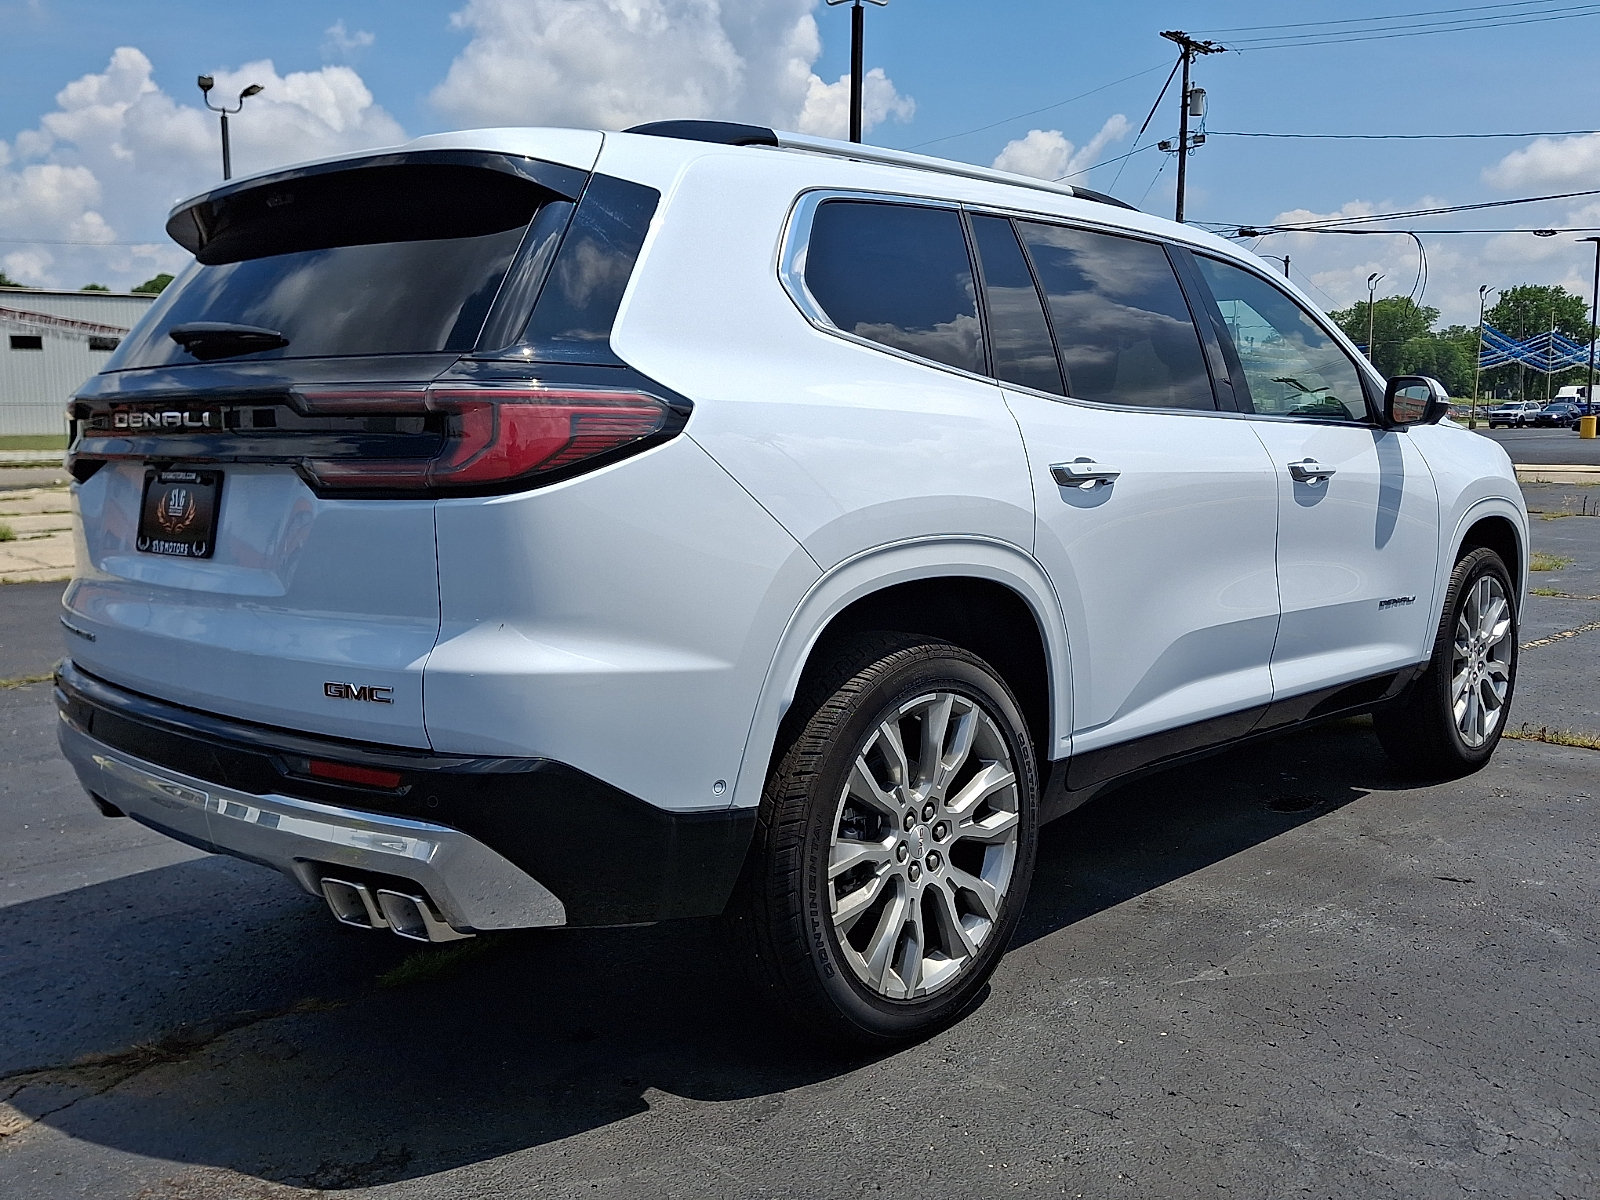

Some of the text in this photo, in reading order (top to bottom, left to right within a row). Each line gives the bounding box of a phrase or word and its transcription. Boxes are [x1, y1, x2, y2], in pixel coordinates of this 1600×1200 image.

[114, 411, 211, 428] DENALI
[1378, 595, 1417, 608] DENALI
[323, 680, 395, 704] GMC
